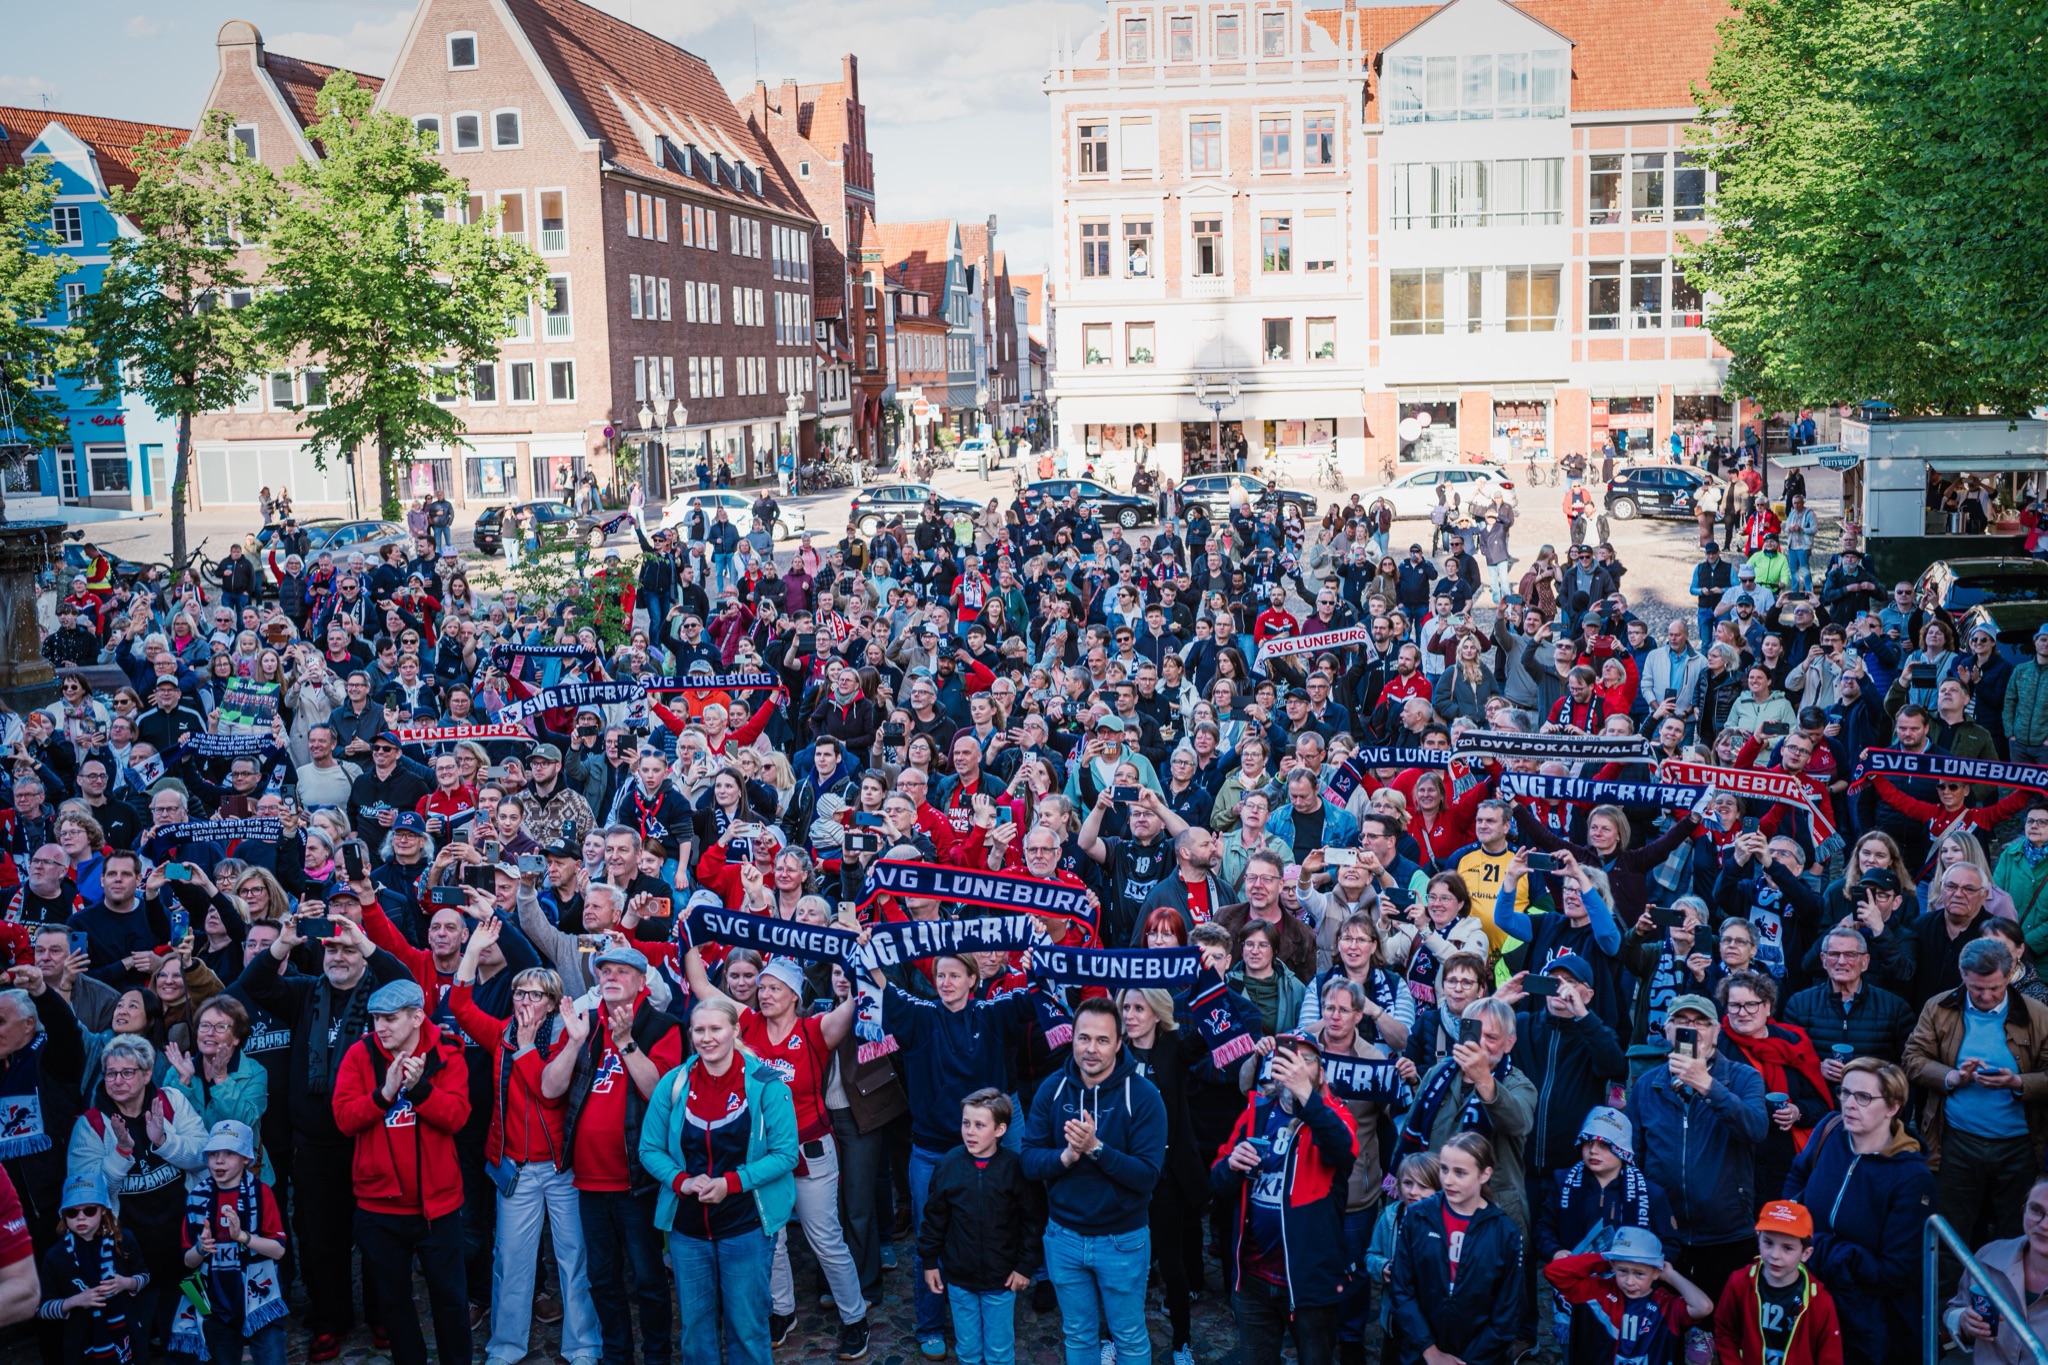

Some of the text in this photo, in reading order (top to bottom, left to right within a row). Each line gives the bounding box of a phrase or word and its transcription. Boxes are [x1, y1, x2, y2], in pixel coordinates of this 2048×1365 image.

[1267, 629, 1366, 655] SVG LÜNEBURG
[640, 673, 772, 688] SVG LÜNEBURG
[523, 690, 558, 715] SVG
[400, 723, 517, 741] LÜNEBURG
[1359, 747, 1390, 764] SVG
[1480, 739, 1642, 755] DVV-POKALFINALE
[1688, 767, 1801, 798] LÜNEBUR
[1872, 754, 2048, 787] SVG LÜNEBURG
[1501, 773, 1546, 801] SVG
[157, 825, 177, 837] und
[178, 820, 218, 830] deshalb
[246, 818, 262, 827] ich
[175, 826, 279, 838] die schönste Stadt der
[1548, 812, 1561, 829] 13
[192, 833, 213, 842] liegt
[228, 832, 244, 840] der
[1135, 856, 1151, 874] 18
[1483, 864, 1500, 882] 21
[865, 867, 1094, 917] SVG LÜNEBURG
[703, 912, 857, 960] SVG LÜNEBU
[1077, 956, 1201, 979] LÜNEBUR
[1273, 1126, 1291, 1156] 8
[1638, 1194, 1650, 1226] Welt
[1449, 1230, 1465, 1263] 8
[1621, 1313, 1639, 1342] 11
[1761, 1302, 1784, 1332] 12
